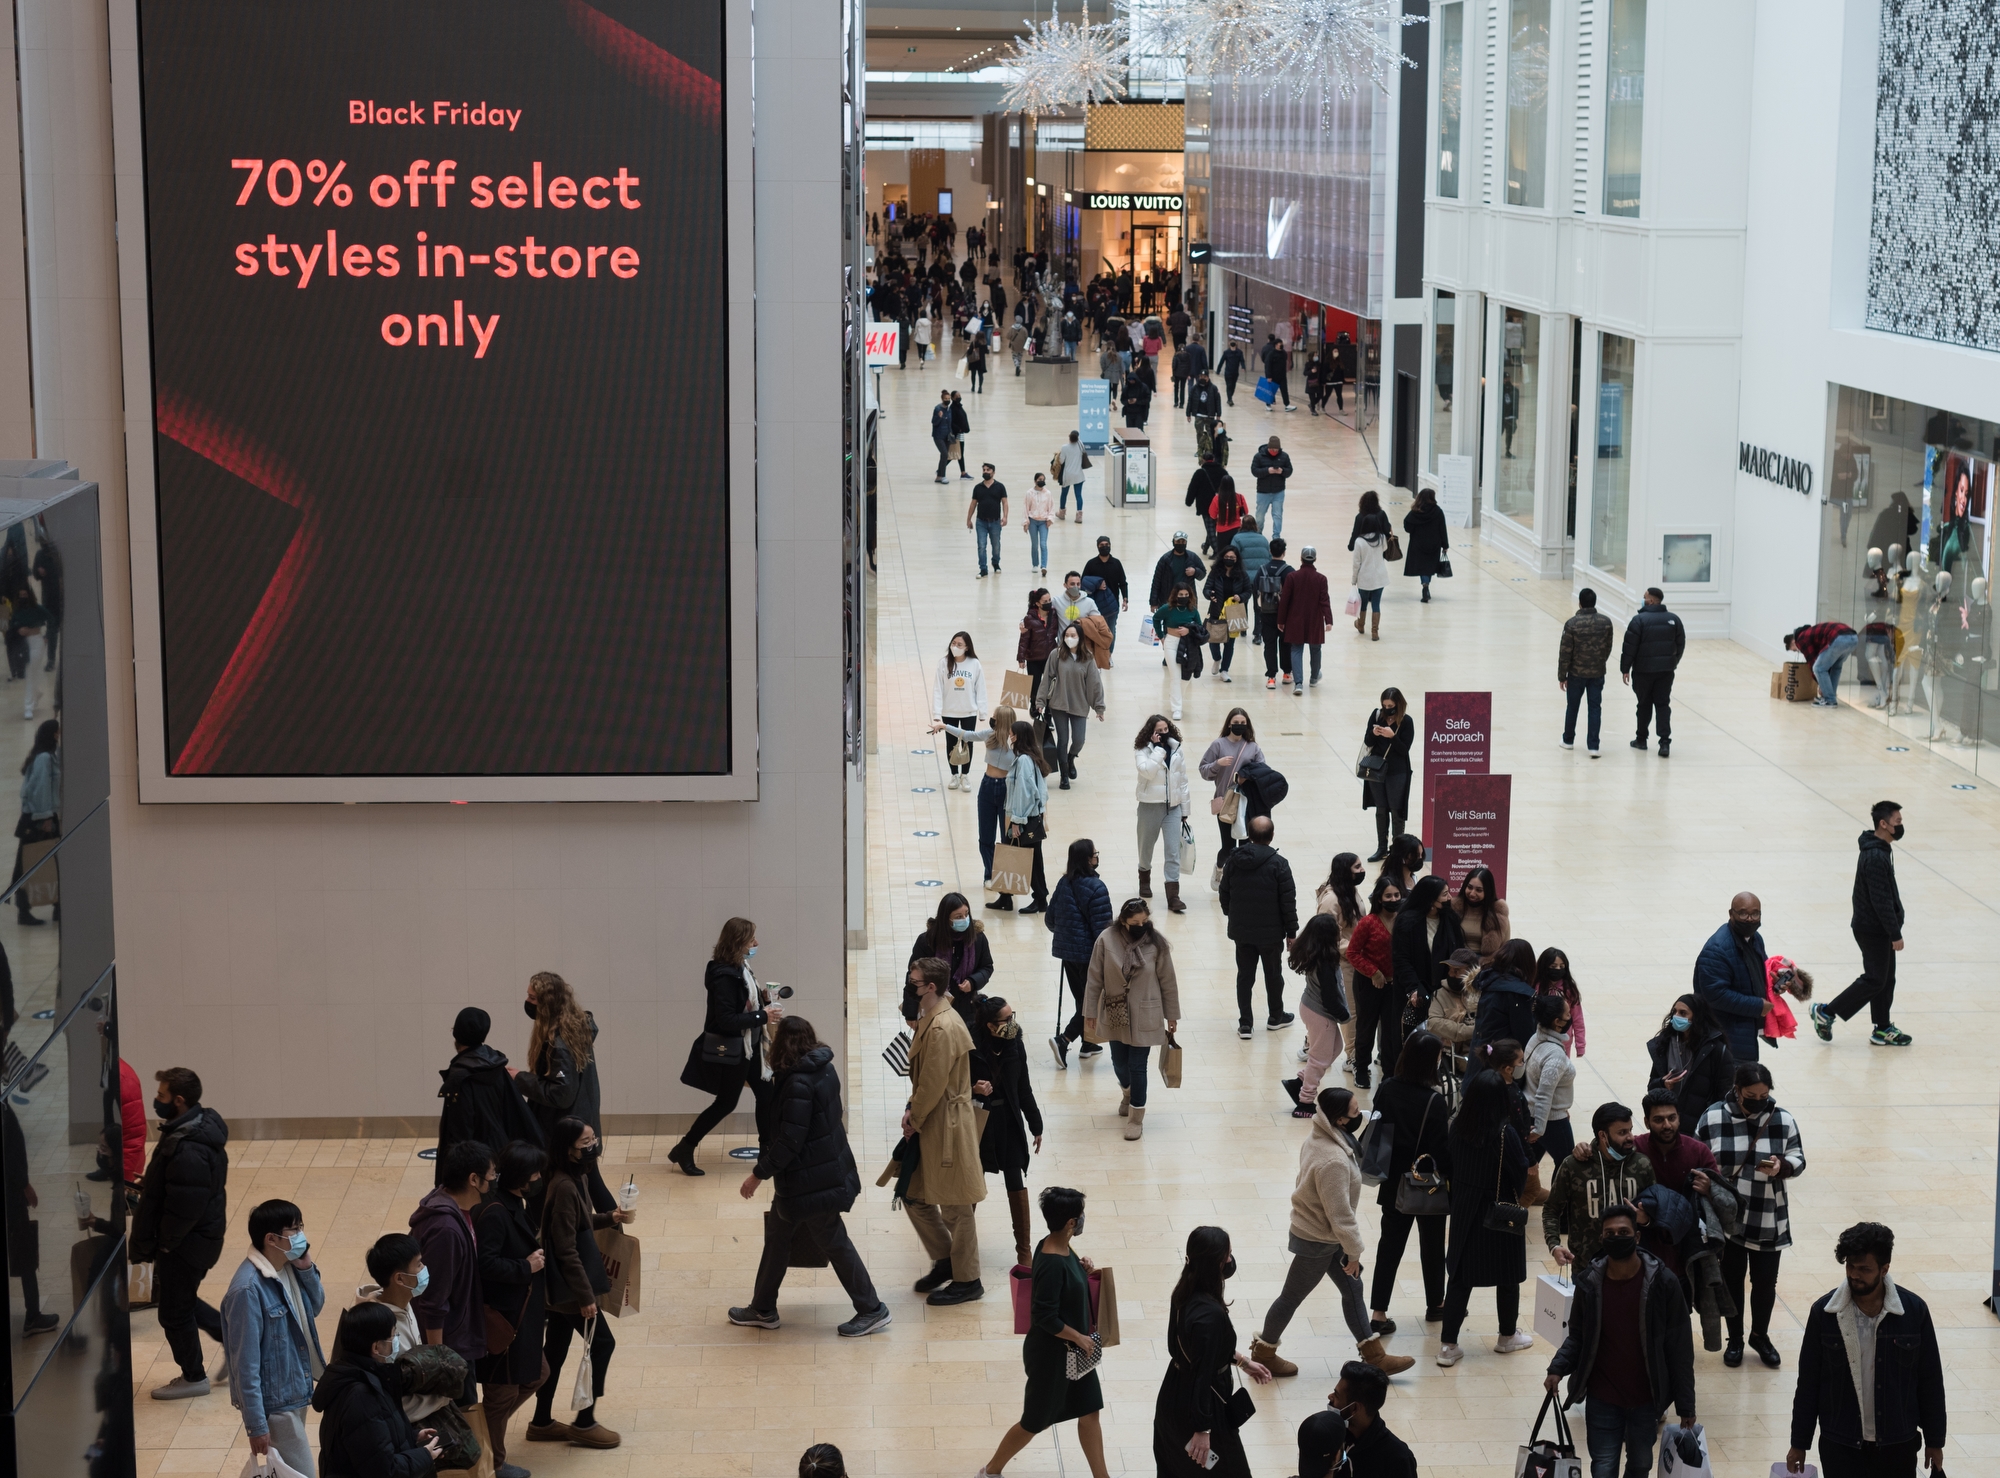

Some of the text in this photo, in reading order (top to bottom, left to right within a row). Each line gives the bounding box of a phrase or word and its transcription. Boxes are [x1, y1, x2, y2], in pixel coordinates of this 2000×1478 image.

[349, 100, 522, 132] Black Friday
[231, 158, 642, 210] 70% off select
[1090, 195, 1183, 210] LOUIS VUITTO
[235, 229, 640, 289] styles in-store
[381, 299, 500, 359] only
[1739, 441, 1812, 495] MARCIANO
[1785, 664, 1799, 700] Indigo
[1431, 731, 1484, 744] Approach
[1445, 718, 1471, 730] Safe
[1448, 810, 1496, 820] Visit Santa
